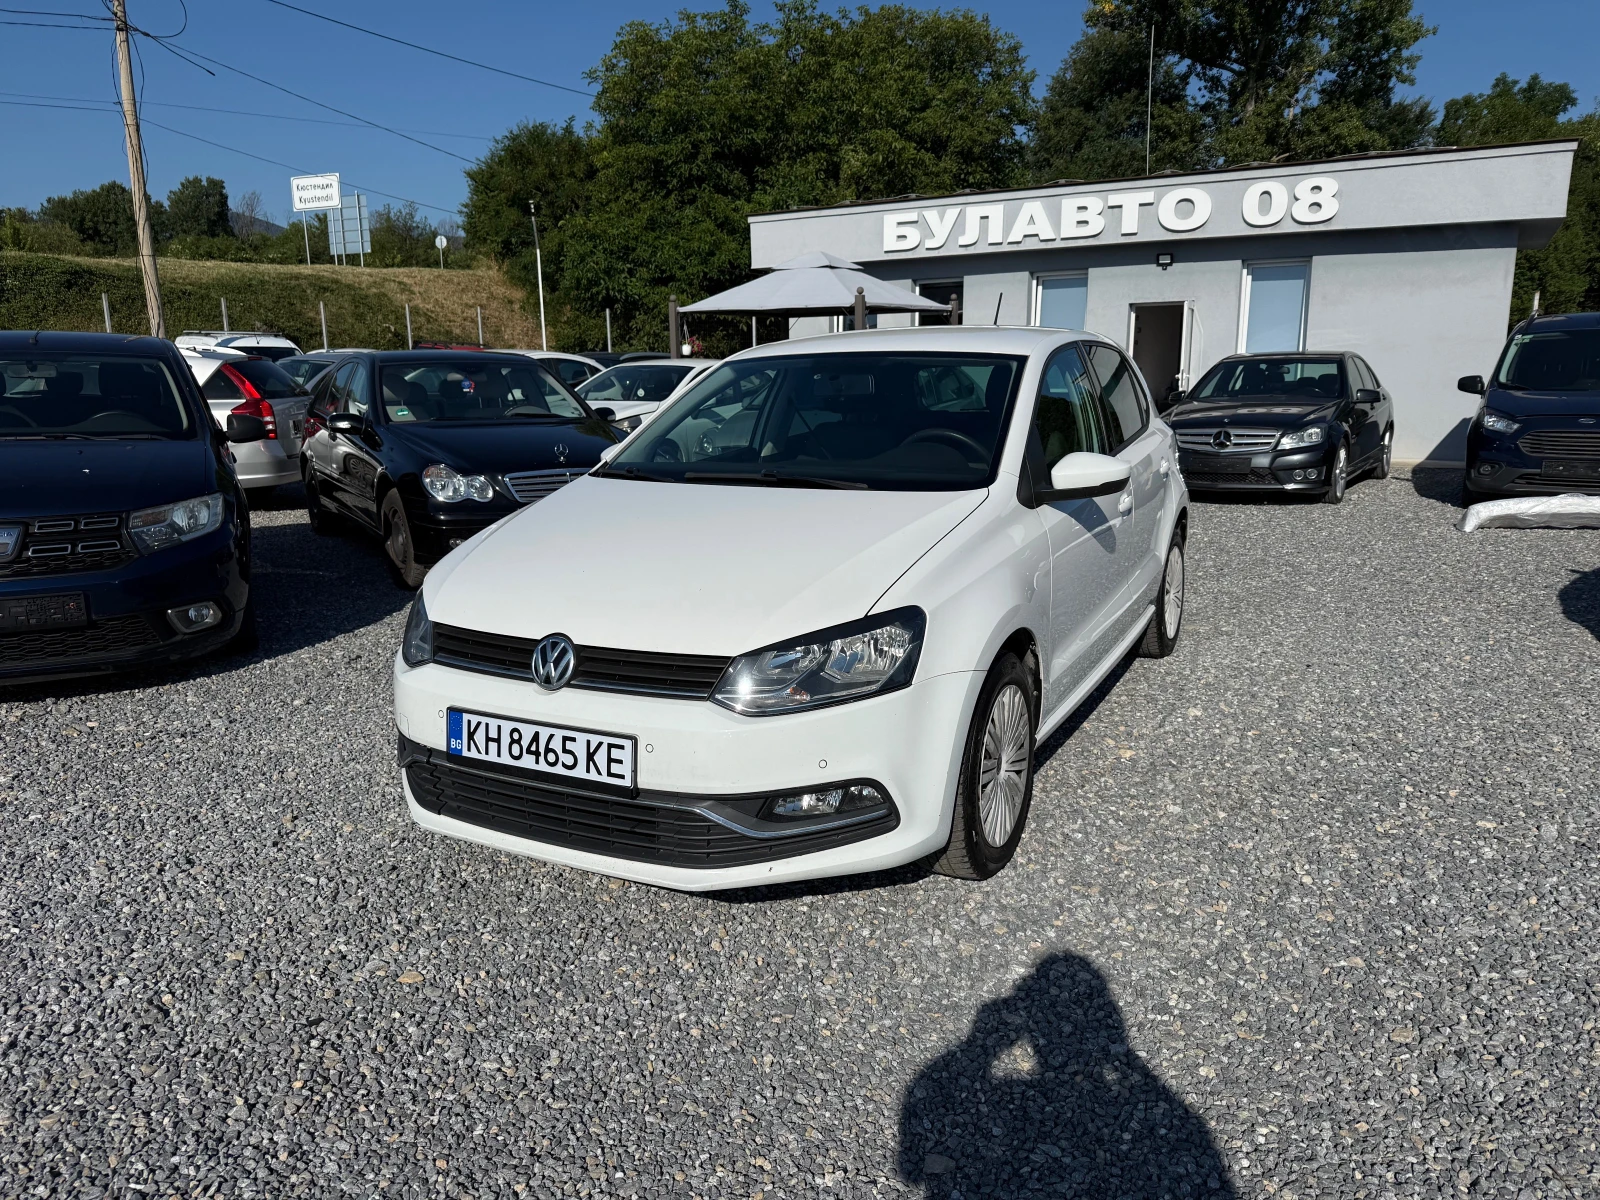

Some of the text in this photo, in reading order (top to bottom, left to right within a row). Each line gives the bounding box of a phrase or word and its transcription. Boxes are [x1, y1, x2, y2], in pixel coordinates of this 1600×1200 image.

[296, 182, 334, 192] Кюстендил
[298, 193, 334, 205] Kyustendil
[883, 176, 1340, 253] БУЛАВТО 08
[450, 738, 462, 750] BG
[507, 726, 579, 771] 8465
